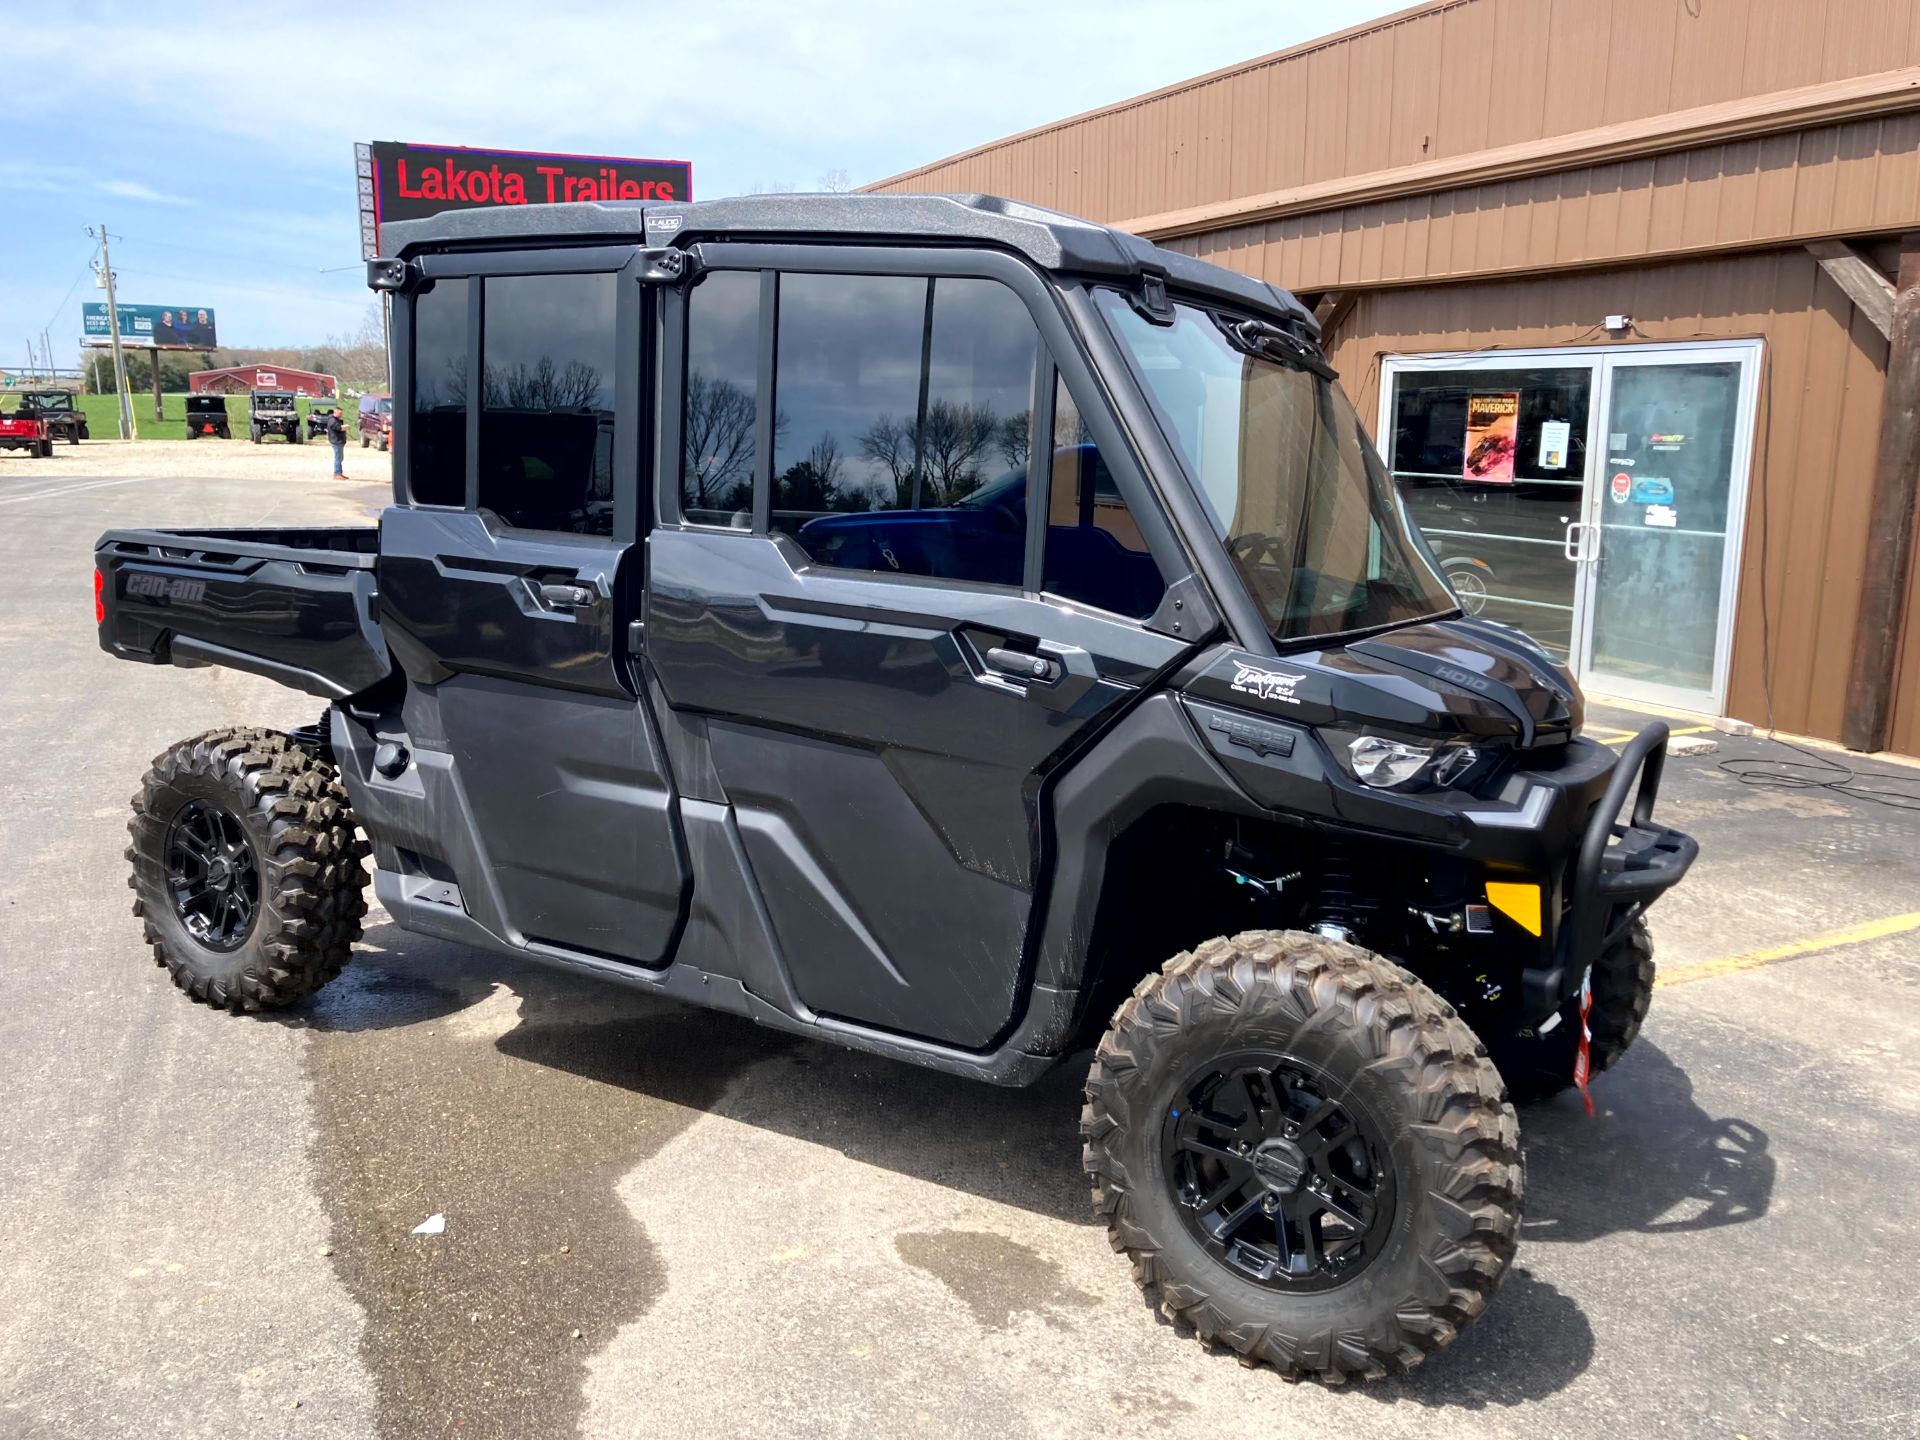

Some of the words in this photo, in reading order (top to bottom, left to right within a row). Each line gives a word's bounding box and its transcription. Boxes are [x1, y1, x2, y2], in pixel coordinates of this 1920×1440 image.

[398, 158, 528, 205] Lakota
[537, 166, 675, 203] Trailers
[1472, 403, 1514, 414] MAVERICK
[126, 573, 207, 601] can-am
[1435, 666, 1490, 691] HD10
[1212, 716, 1295, 743] DEFENDER
